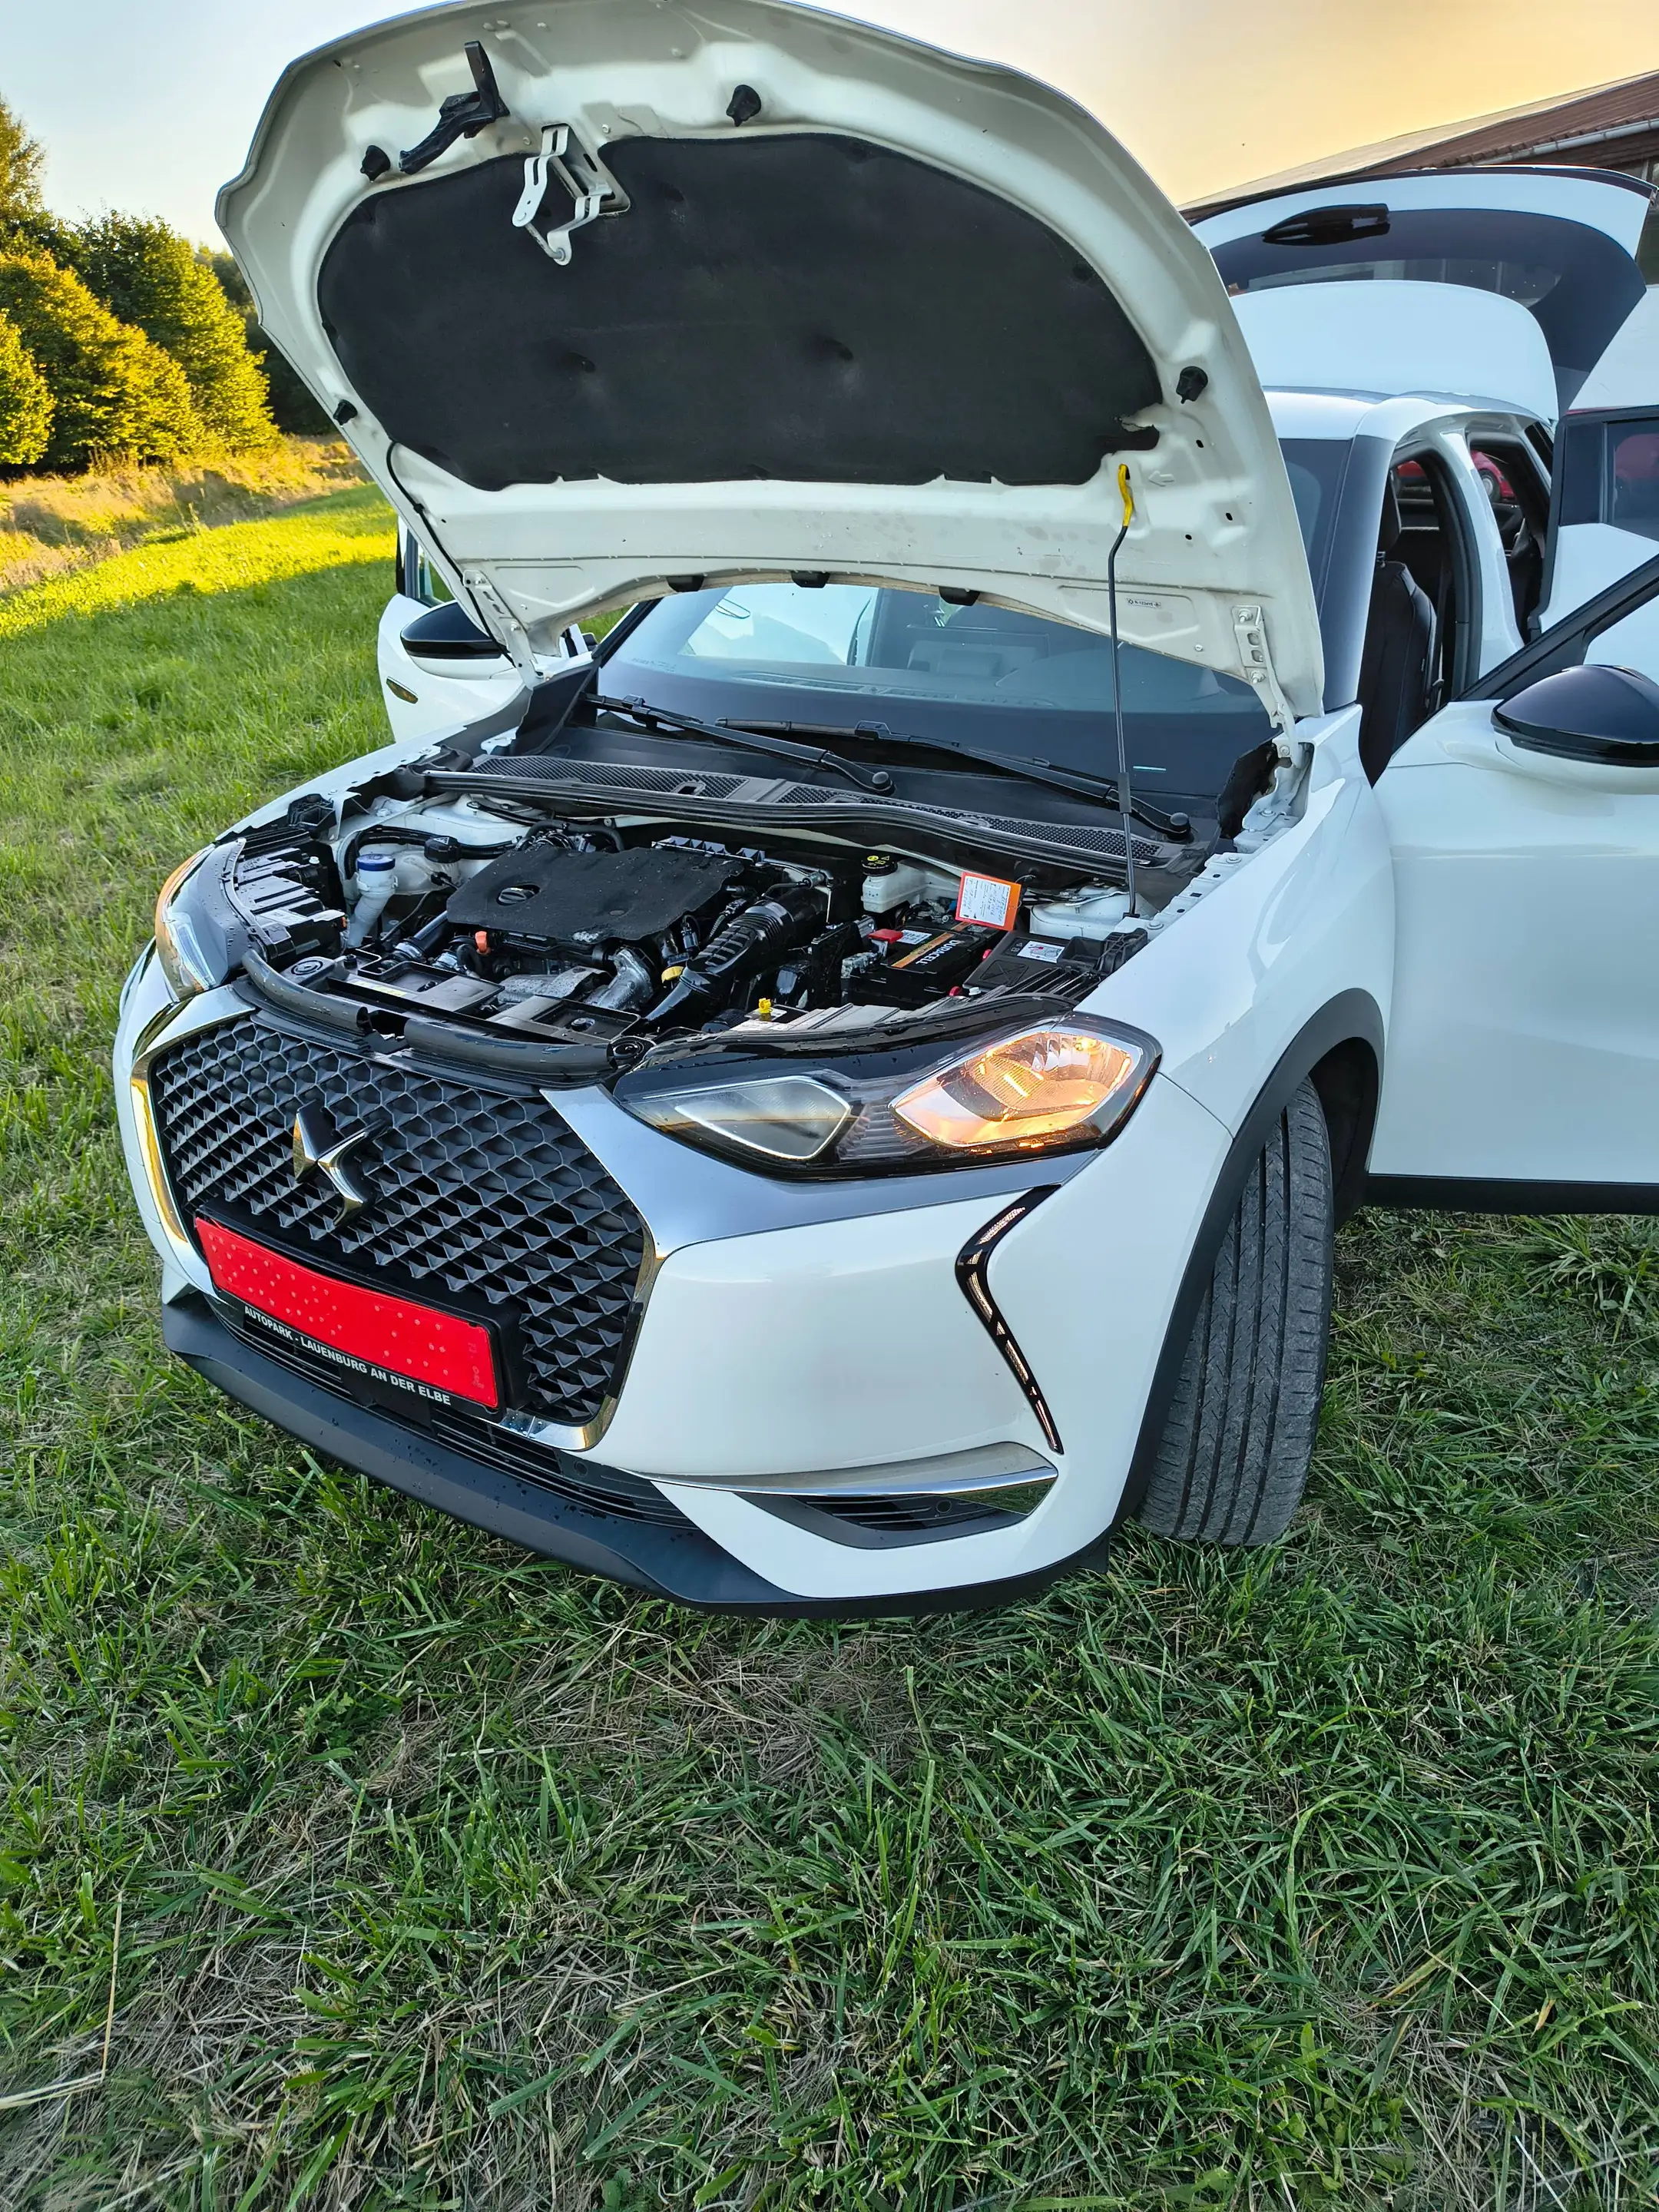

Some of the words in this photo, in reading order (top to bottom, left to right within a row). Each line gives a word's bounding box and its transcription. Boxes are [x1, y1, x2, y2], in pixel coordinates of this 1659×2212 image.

[915, 939, 959, 965] DURACELL
[244, 1306, 293, 1340] AUTOPARK
[300, 1336, 367, 1373] LAUENBURG
[371, 1368, 387, 1382] AN
[389, 1375, 416, 1392] DER
[418, 1385, 452, 1406] ELBE
